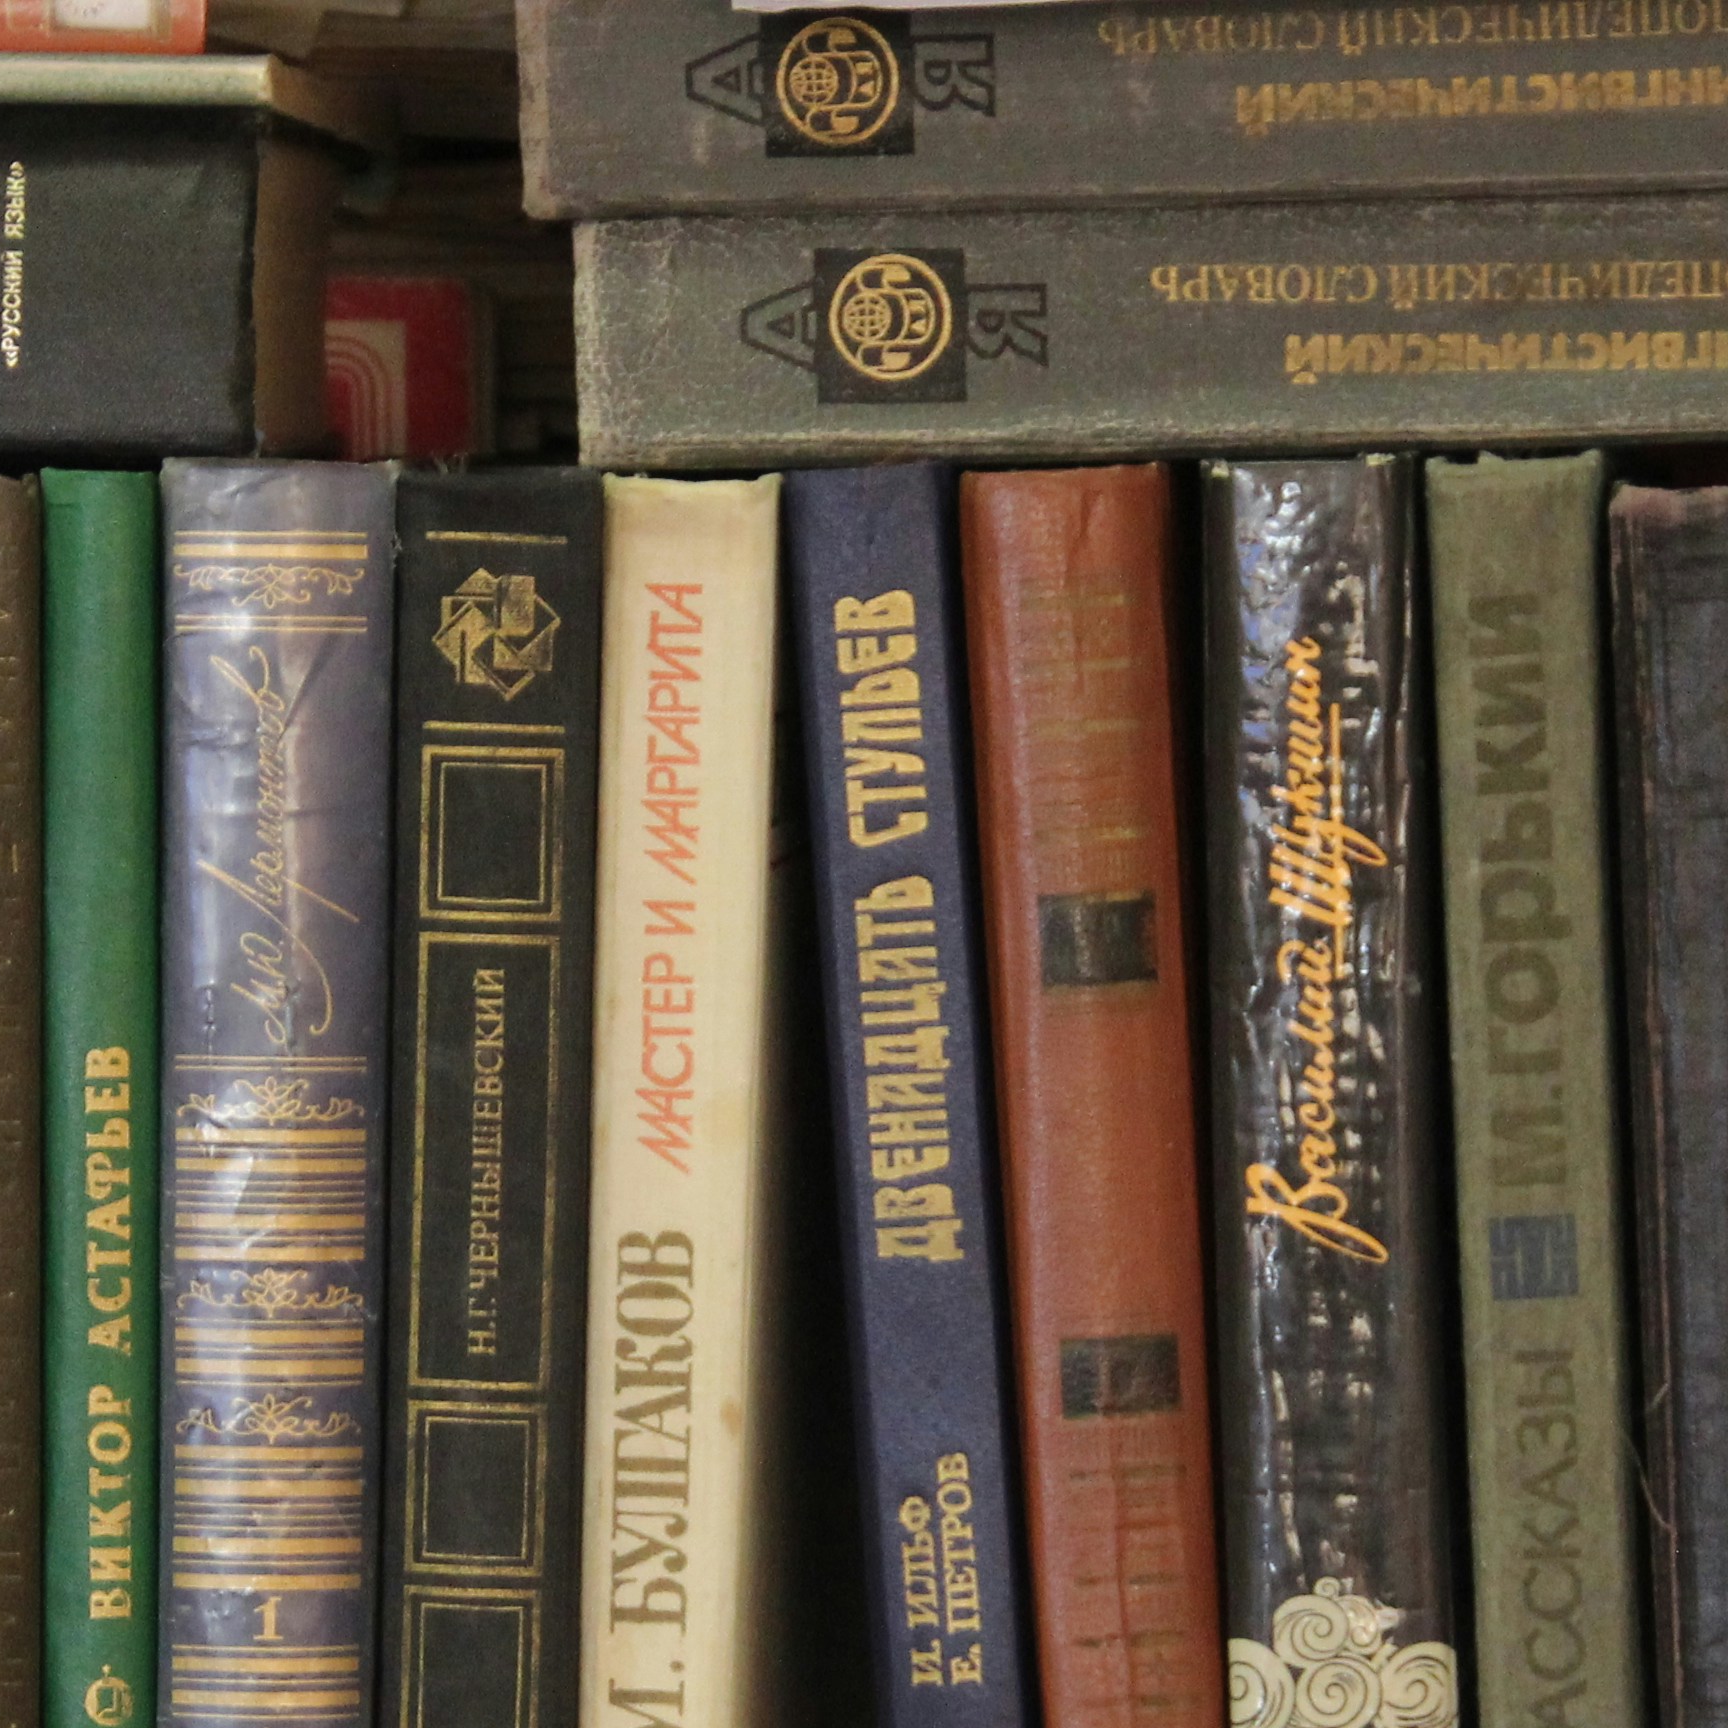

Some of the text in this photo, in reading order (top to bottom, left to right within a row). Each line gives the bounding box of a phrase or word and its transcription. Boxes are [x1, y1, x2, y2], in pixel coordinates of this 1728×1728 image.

[1097, 6, 1325, 56] СЛОВАРЬ
[1148, 261, 1379, 307] СЛОВАРЬ
[640, 582, 703, 885] МАРГАРИТА
[642, 900, 696, 935] И
[832, 589, 967, 1264] ДВЕНАДЦАТЬ СТУЛЬЕВ
[635, 953, 696, 1176] МАСТЕР
[1245, 937, 1389, 1263] Василий
[84, 1045, 133, 1620] ВИКТОР АСТАФЬЕВ
[608, 1229, 695, 1635] БУЛГАКОВ
[898, 1496, 943, 1688] И. ИЛЬФ
[935, 1452, 984, 1685] Е. ПЕТРОВ
